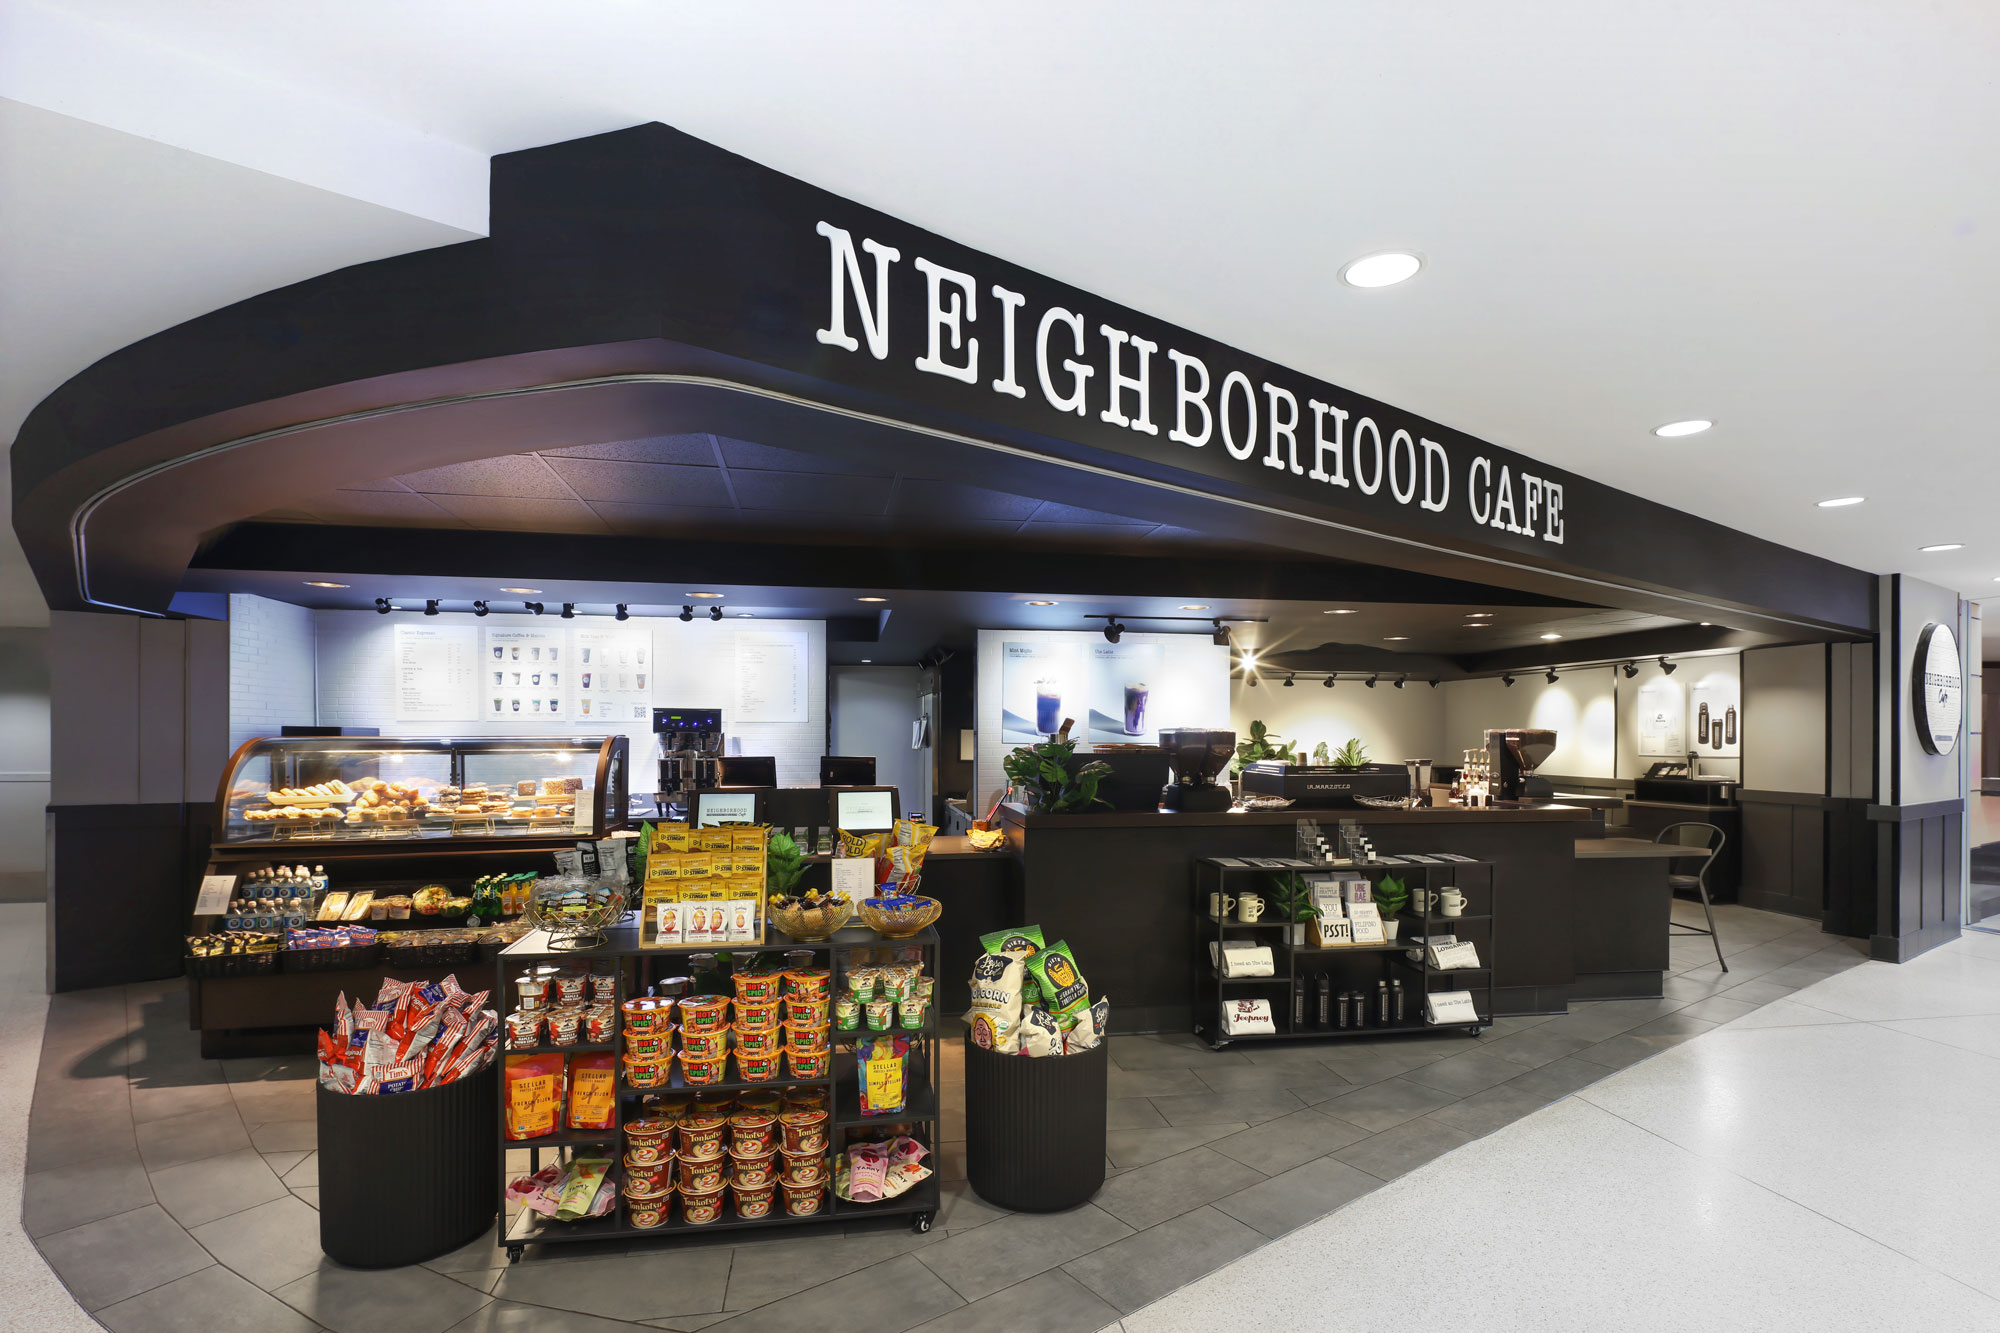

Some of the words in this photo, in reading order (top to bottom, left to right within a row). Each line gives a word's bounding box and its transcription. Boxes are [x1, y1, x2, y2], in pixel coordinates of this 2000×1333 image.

[815, 220, 1450, 513] NEIGHBORHOOD
[1468, 455, 1565, 545] CAFE
[1354, 884, 1366, 892] UBE
[1324, 924, 1348, 938] PSST!
[1048, 957, 1061, 967] SIETE
[1233, 1013, 1269, 1023] Jeepney
[389, 1070, 407, 1078] Tim's
[520, 1080, 546, 1088] STELLAR
[733, 1130, 765, 1138] Tonkotsu
[736, 1161, 768, 1170] Tonkotsu
[788, 1157, 820, 1167] Tonkotsu
[738, 1192, 771, 1202] Tonkotsu
[788, 1189, 820, 1198] Tonkotsu
[628, 1201, 661, 1210] Tonkotsu
[683, 1197, 717, 1206] Tonkotsu
